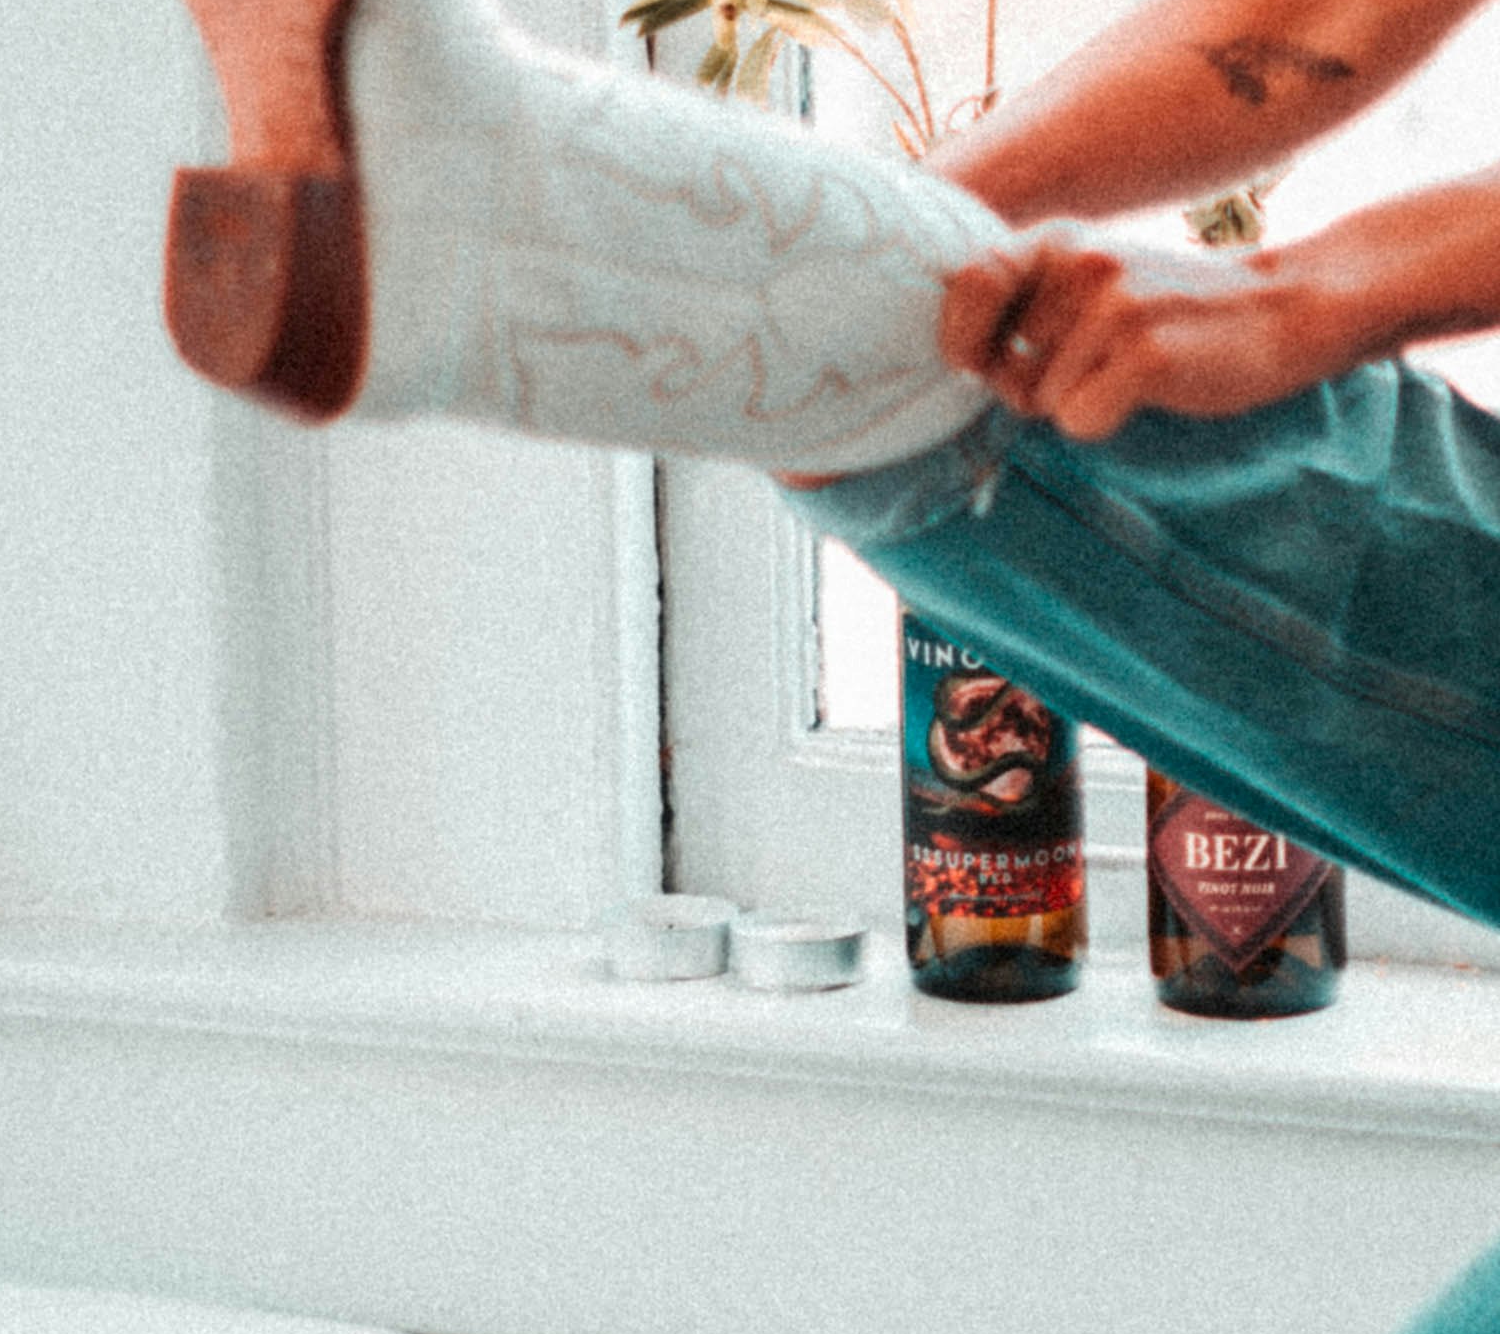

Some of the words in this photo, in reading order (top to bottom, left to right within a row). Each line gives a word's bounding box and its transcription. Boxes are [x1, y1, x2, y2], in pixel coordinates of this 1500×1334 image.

[1184, 831, 1288, 871] BEZI
[1197, 881, 1237, 895] PINOT
[1240, 881, 1276, 895] NOIR
